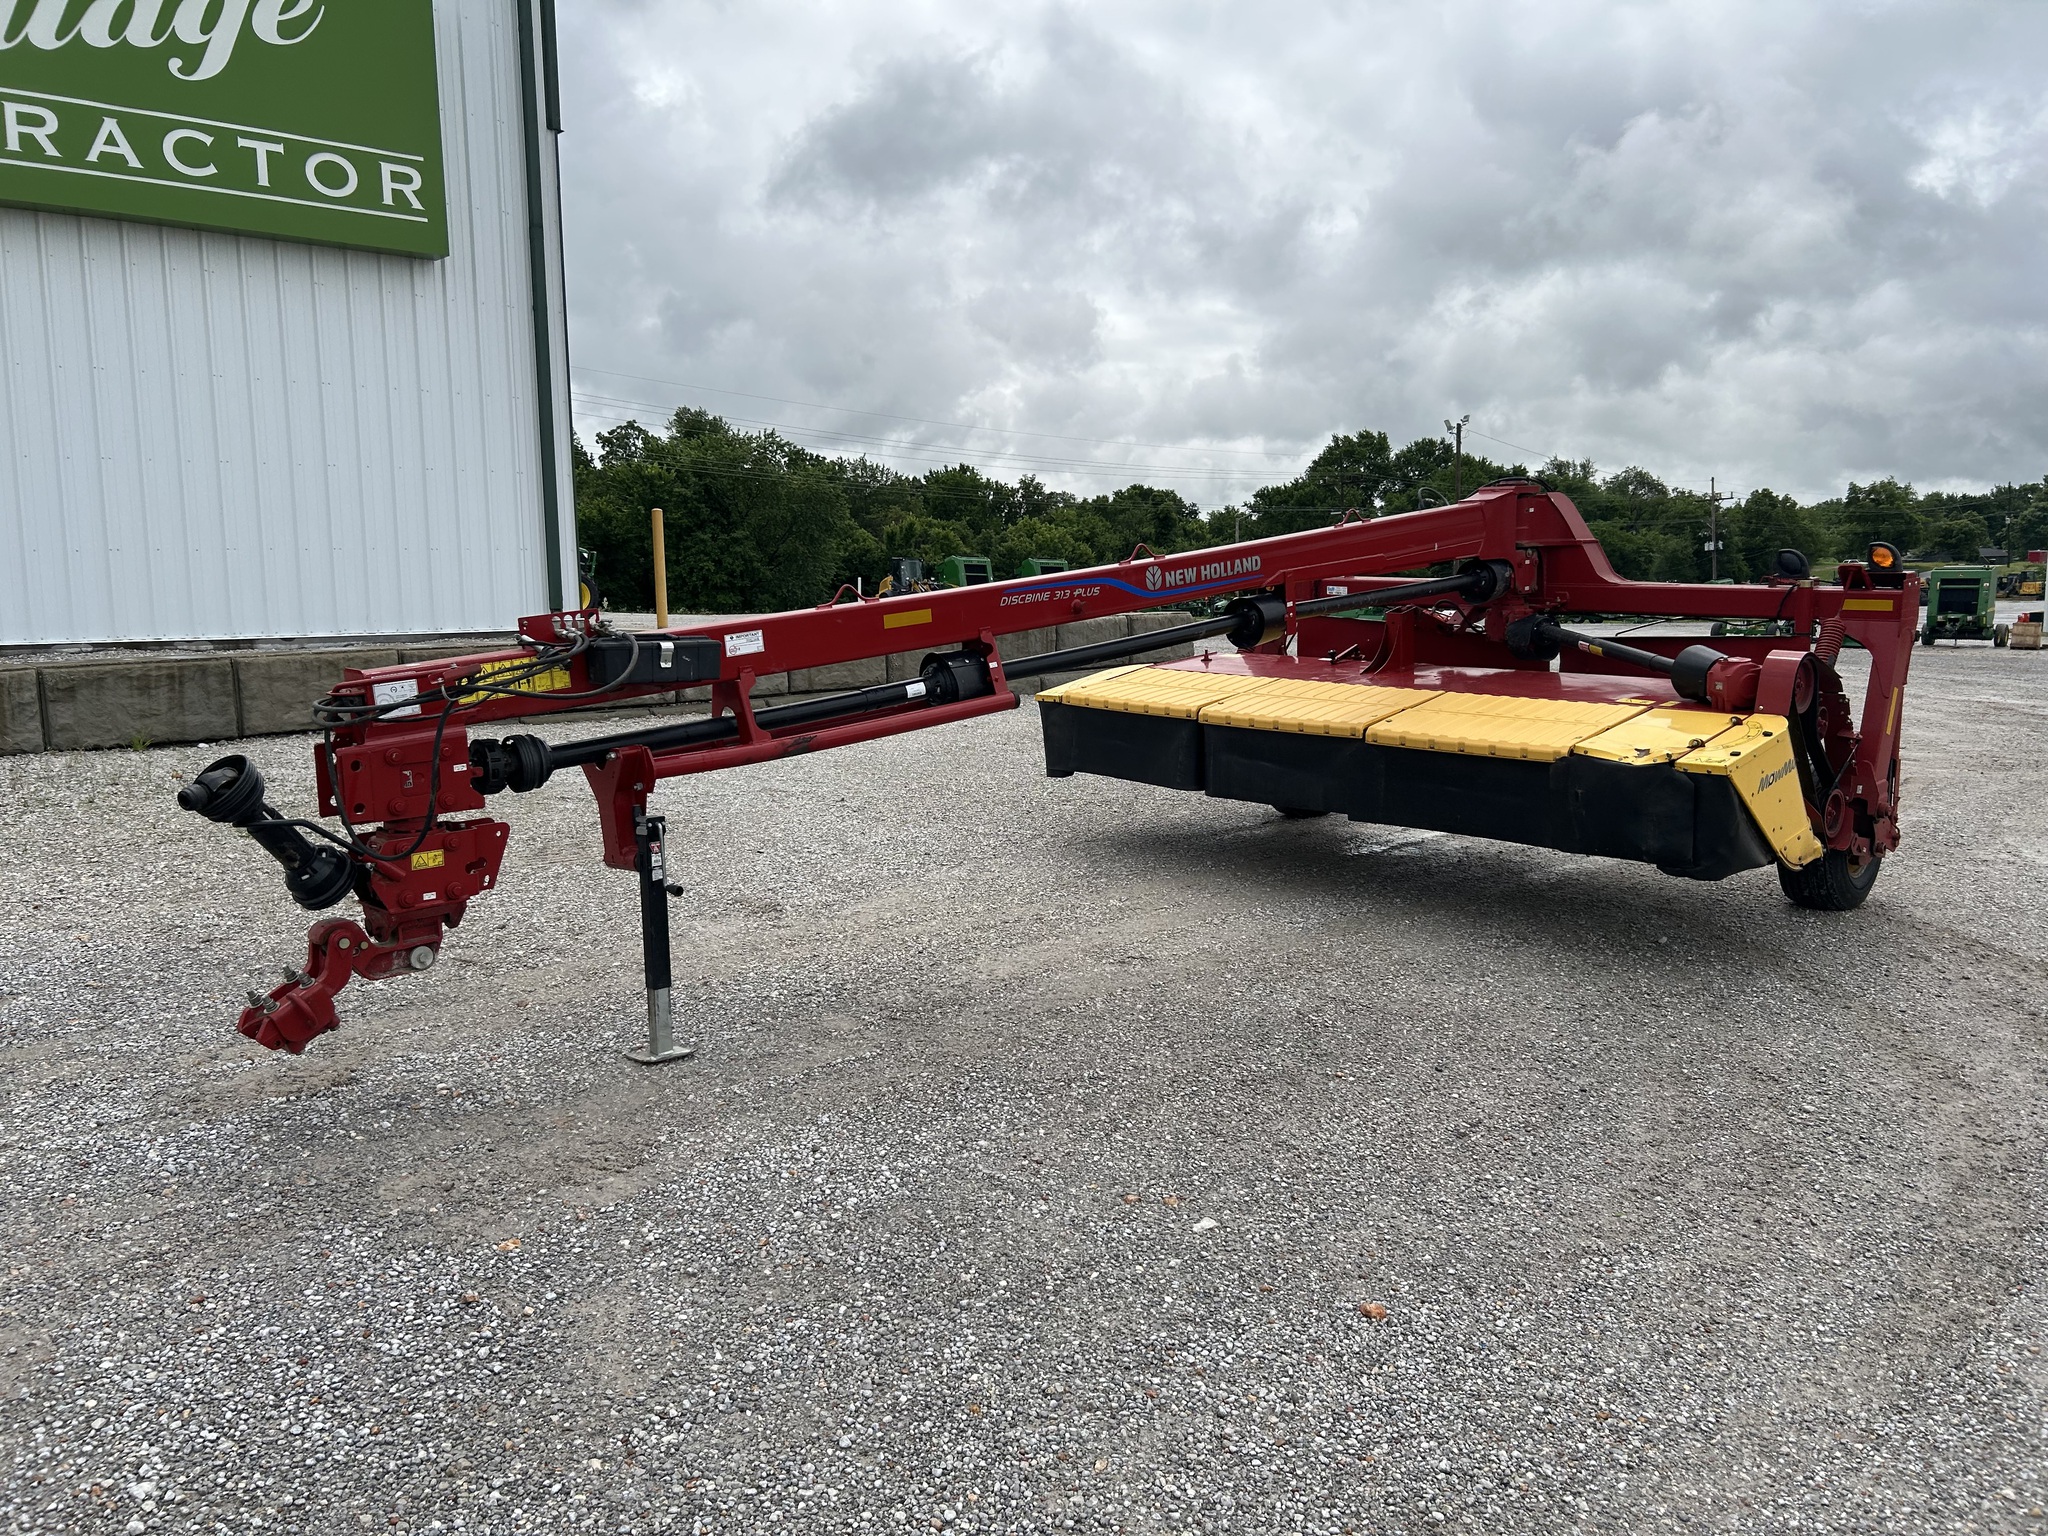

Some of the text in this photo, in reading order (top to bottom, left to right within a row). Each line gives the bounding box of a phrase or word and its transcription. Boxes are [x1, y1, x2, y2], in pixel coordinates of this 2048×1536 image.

[1165, 555, 1261, 588] NEW HOLLAND
[1000, 591, 1051, 607] DISCBINE
[1053, 589, 1071, 601] 313
